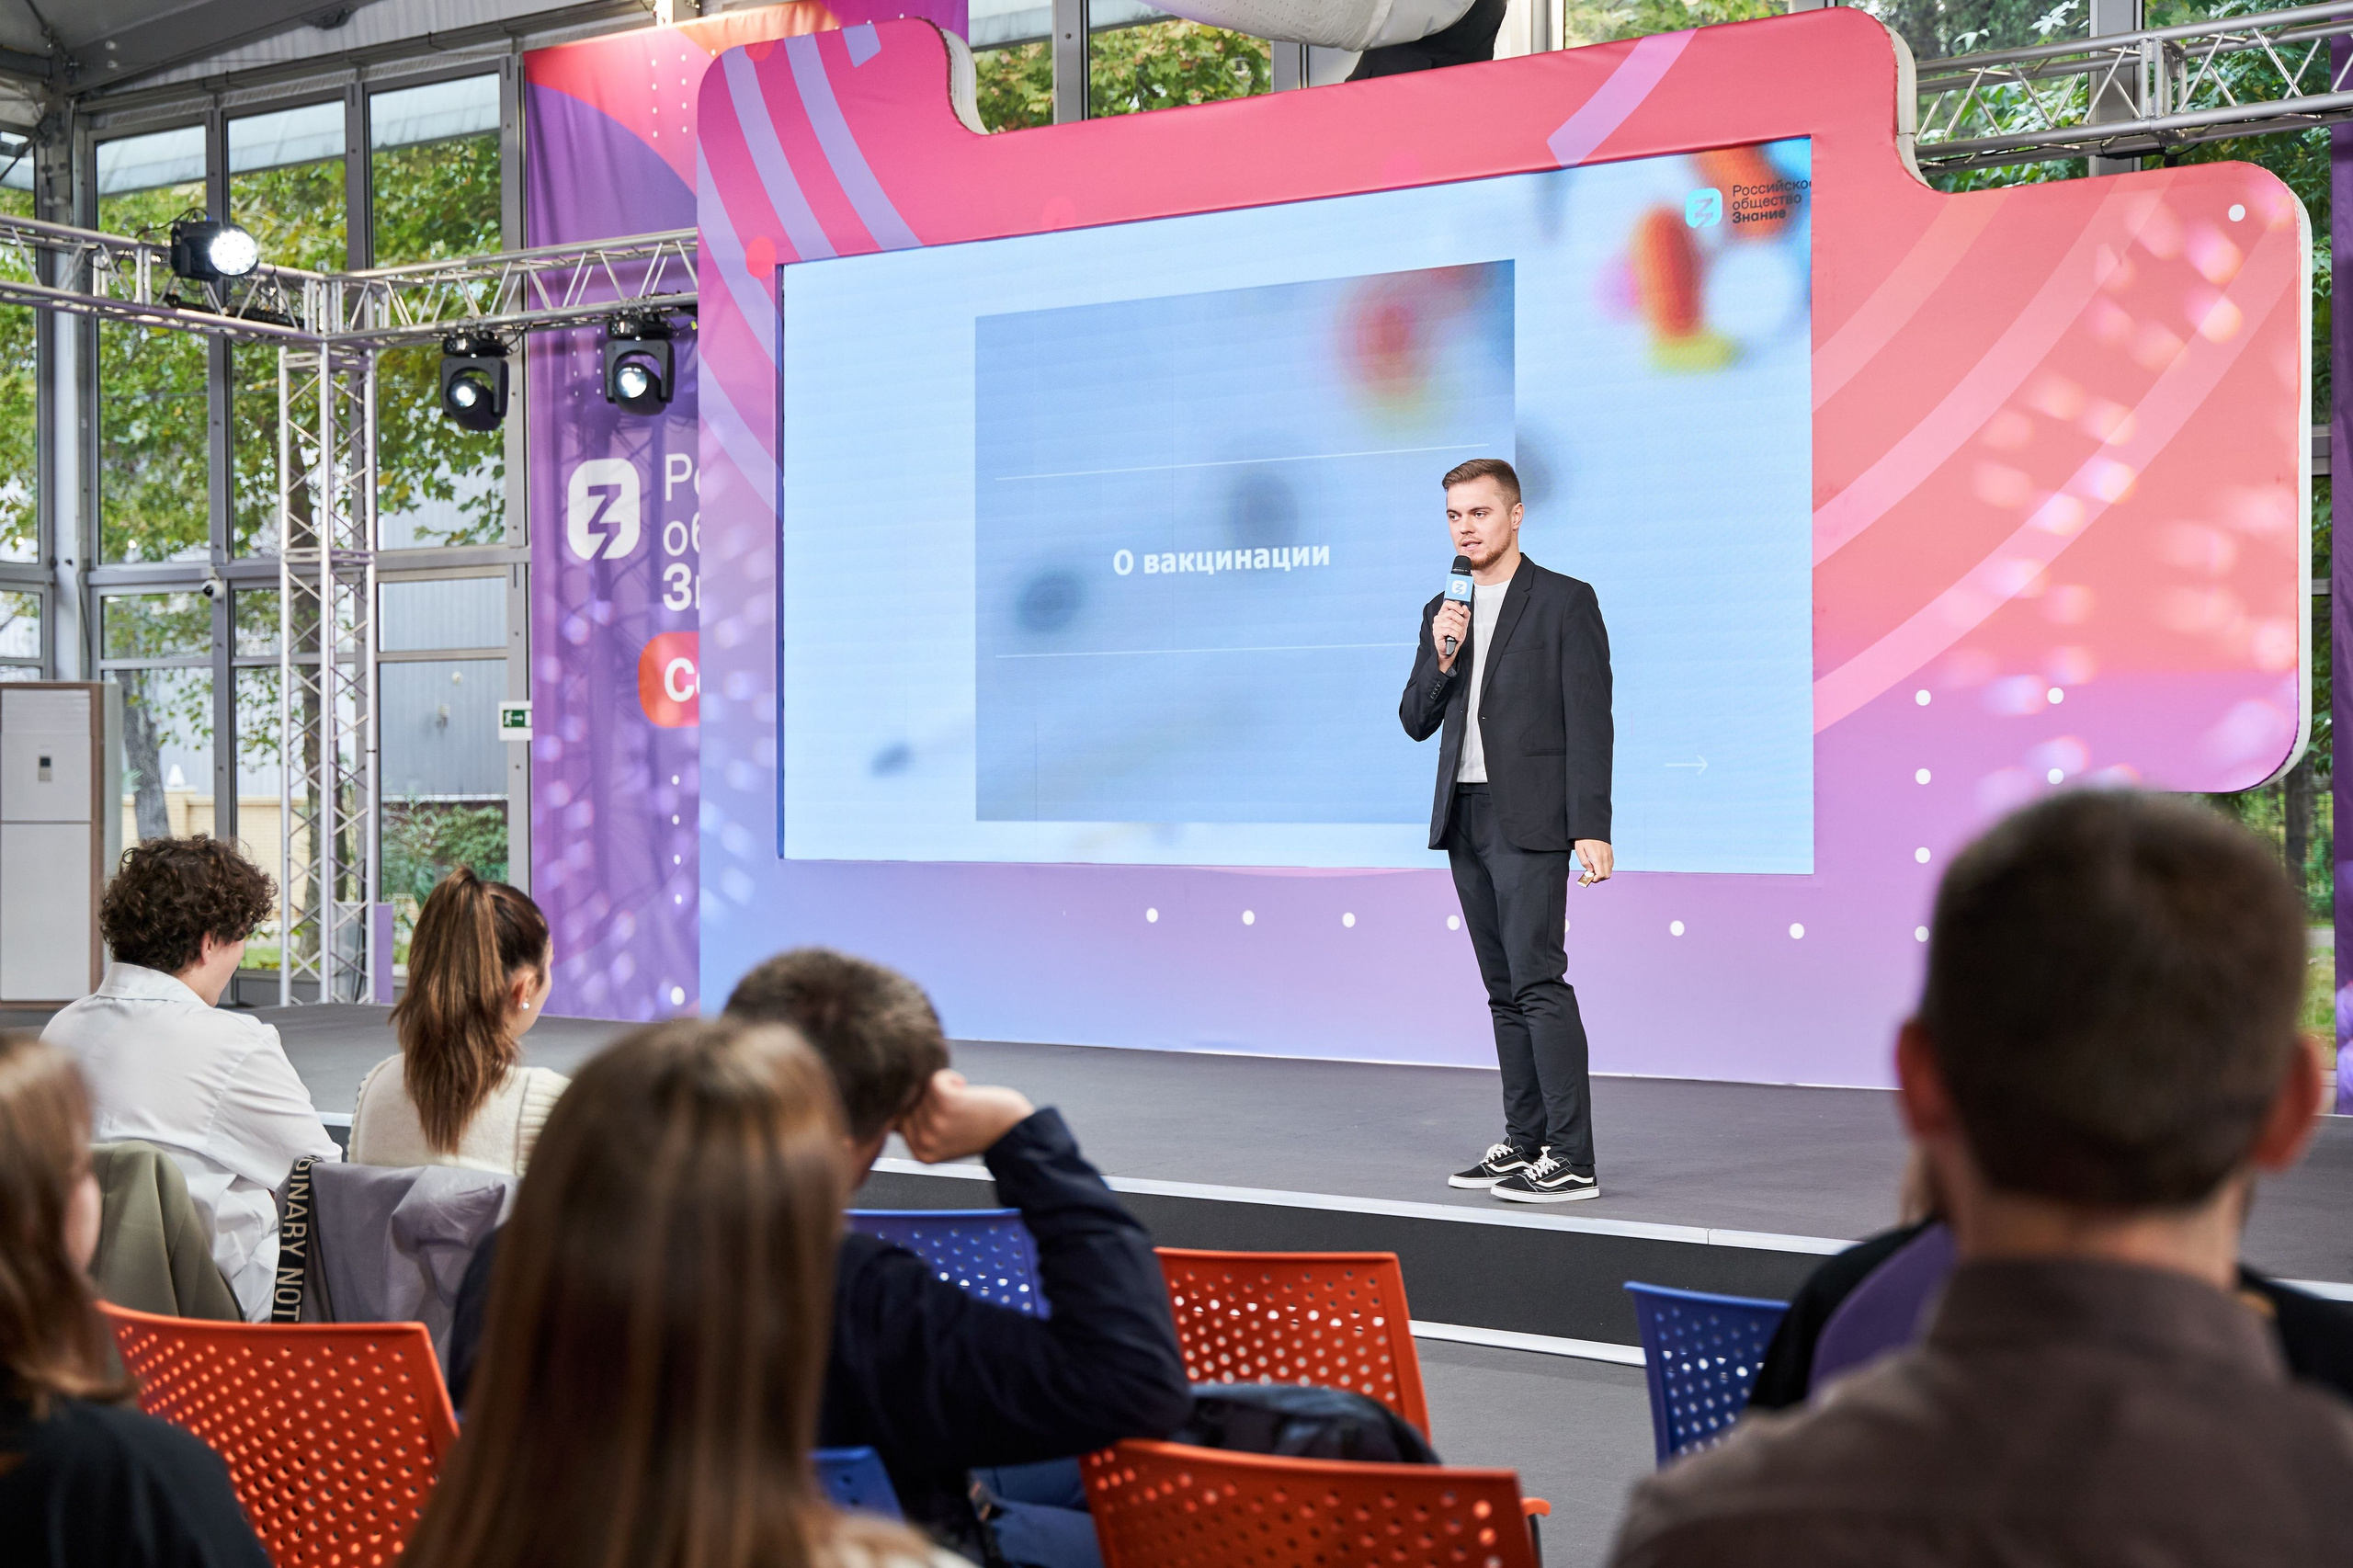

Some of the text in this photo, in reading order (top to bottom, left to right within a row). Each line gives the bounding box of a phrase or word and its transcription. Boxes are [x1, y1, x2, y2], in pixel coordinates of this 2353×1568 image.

[1733, 179, 1812, 197] Российско
[1733, 194, 1802, 210] общество
[1733, 209, 1787, 223] Знание
[665, 452, 699, 502] Р
[1113, 545, 1330, 575] О вакцинации
[662, 562, 699, 612] З
[664, 656, 699, 702] С
[272, 1155, 321, 1323] DINARY NOT
